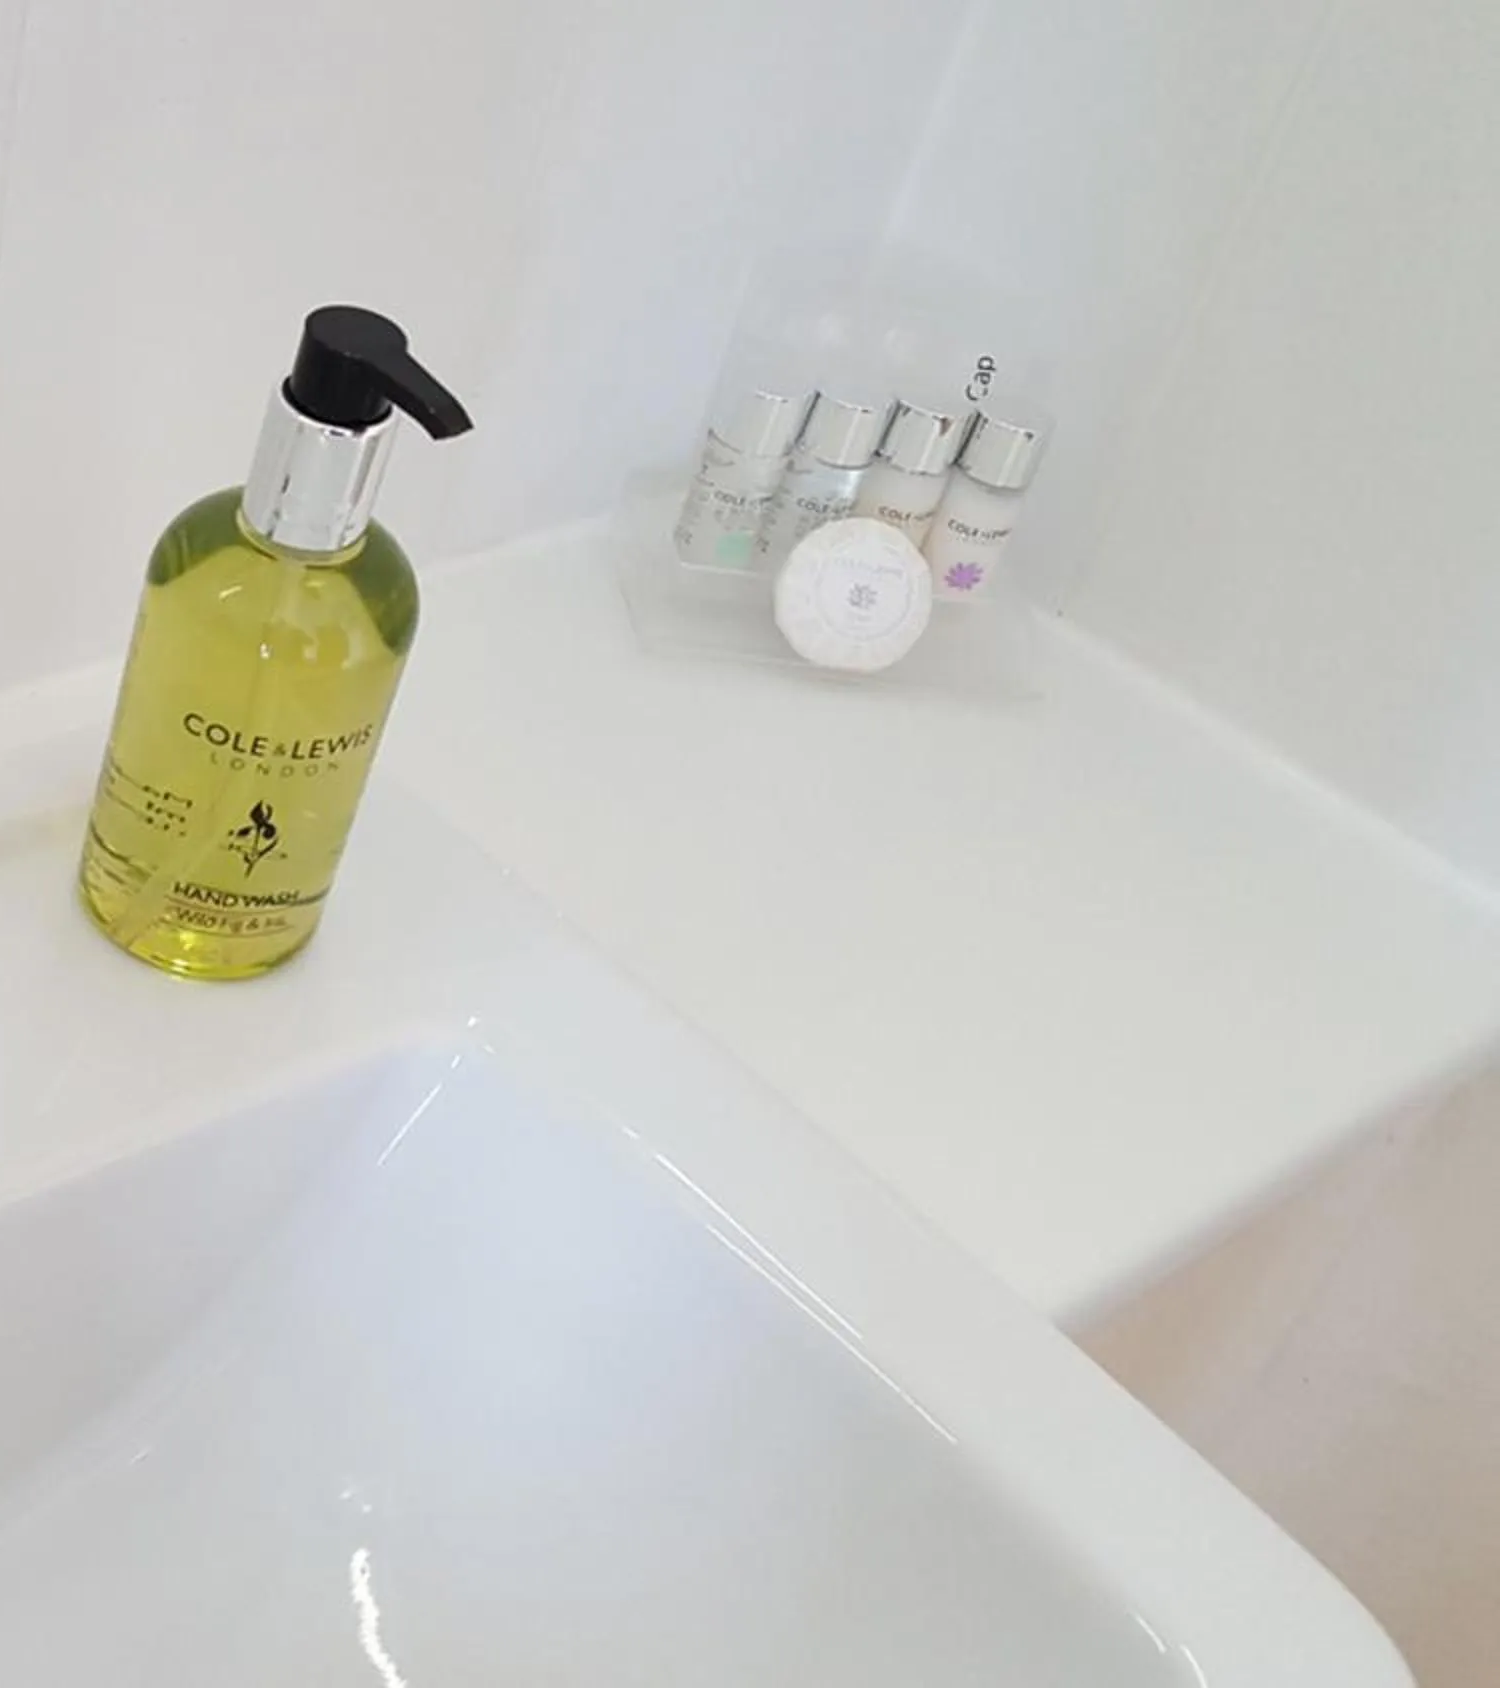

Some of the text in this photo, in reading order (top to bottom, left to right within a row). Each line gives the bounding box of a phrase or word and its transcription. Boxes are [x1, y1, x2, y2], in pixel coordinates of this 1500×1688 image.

[965, 356, 996, 401] Cap
[183, 712, 269, 757] COLE
[290, 723, 373, 760] LEWIS
[210, 751, 340, 778] LONDON
[173, 881, 300, 908] HAND WASH
